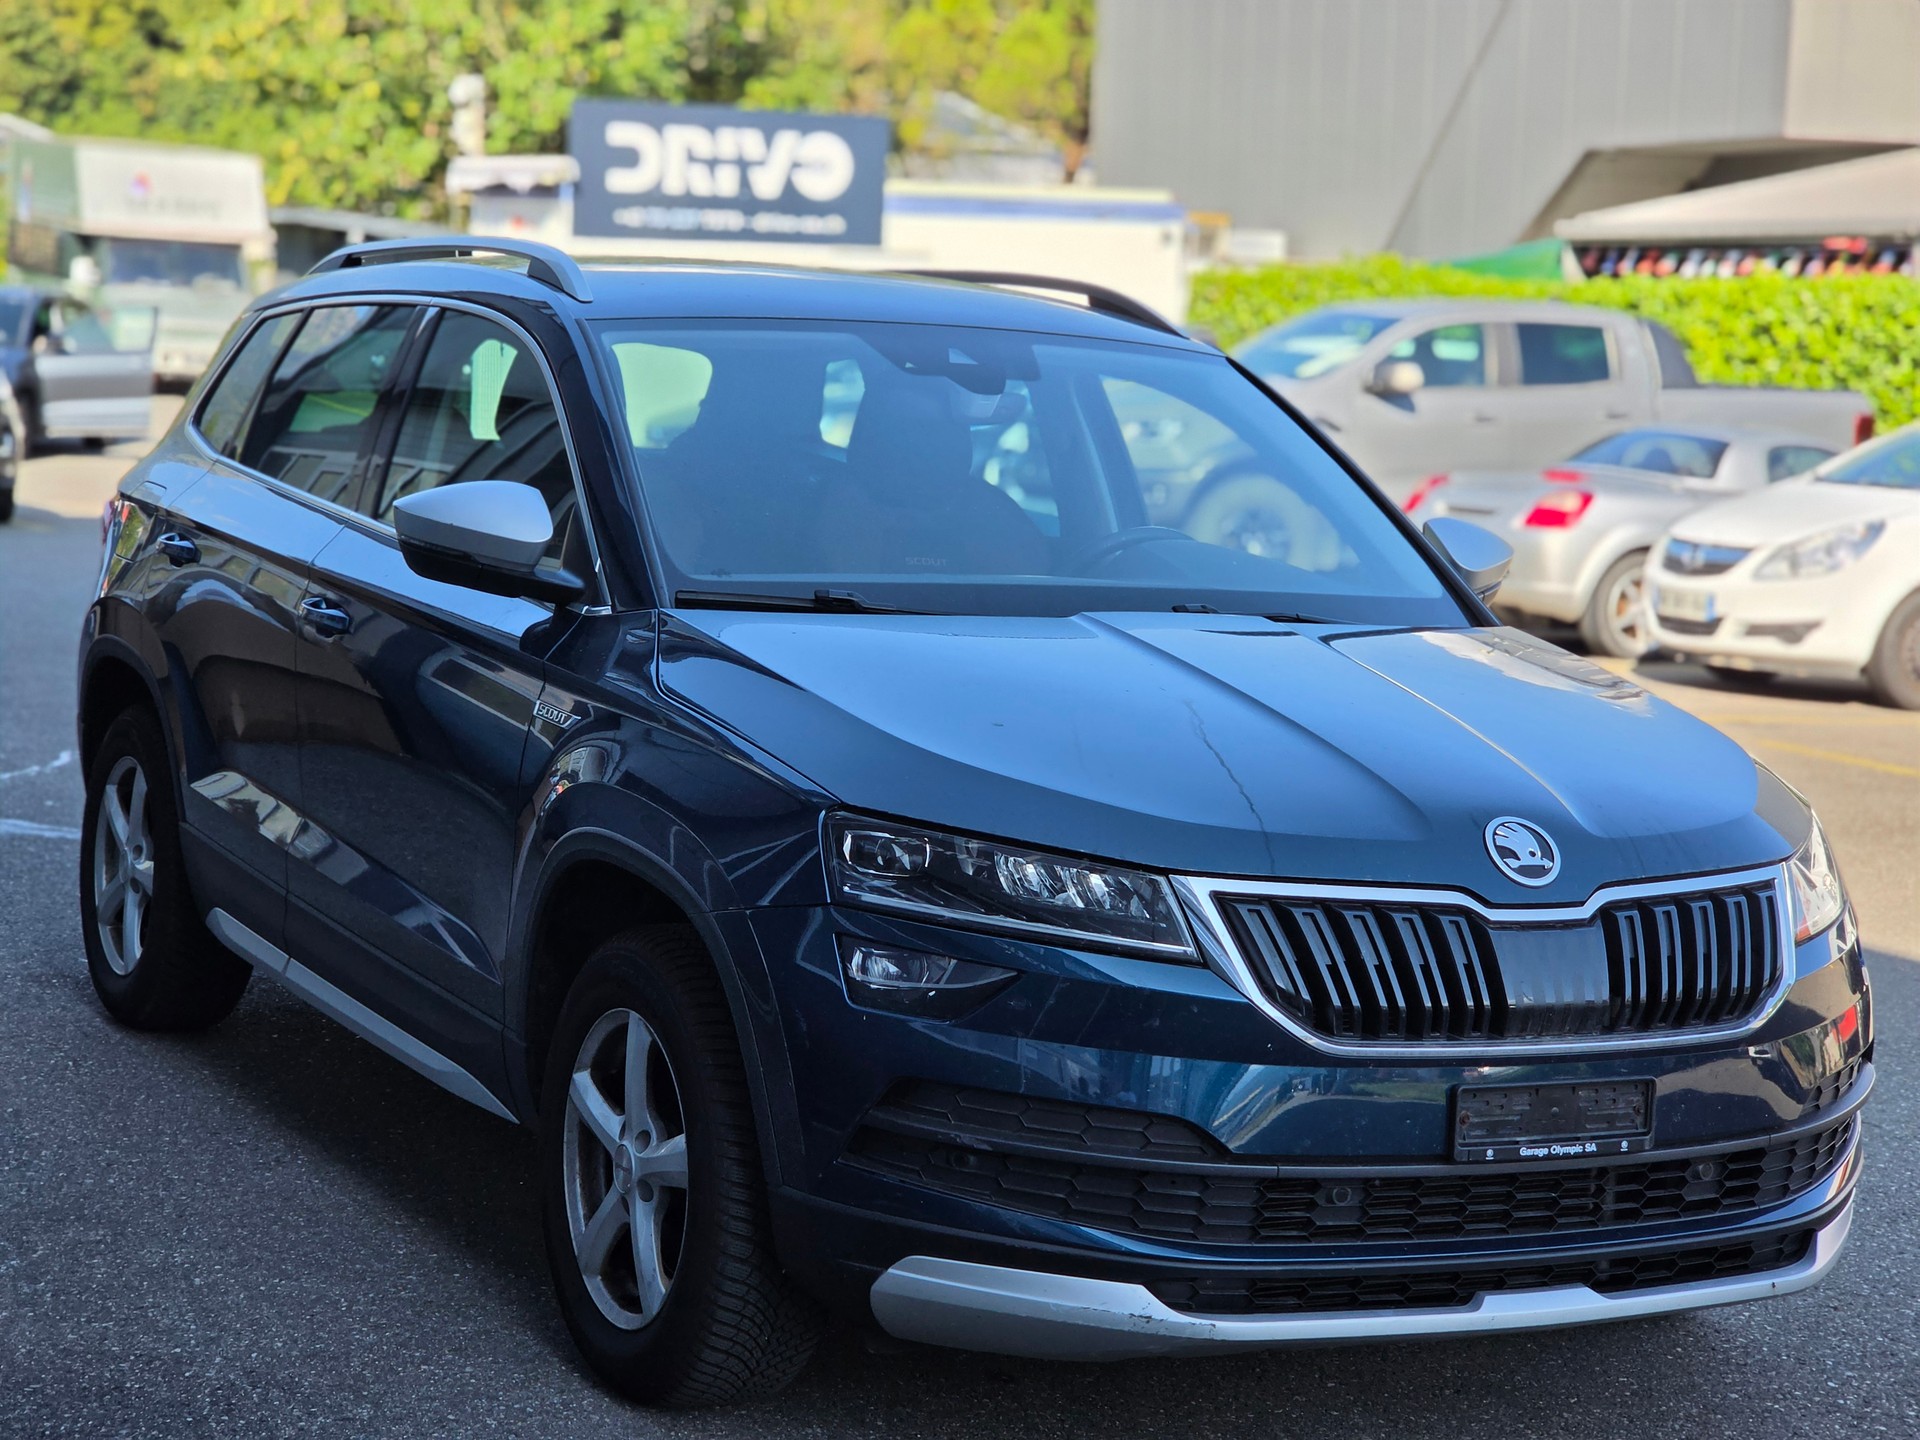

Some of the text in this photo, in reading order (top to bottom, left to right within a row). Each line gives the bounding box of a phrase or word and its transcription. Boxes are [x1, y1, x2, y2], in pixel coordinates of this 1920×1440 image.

[905, 557, 947, 567] SCOUT
[537, 703, 568, 724] SCOUT
[1520, 1142, 1597, 1157] Garage Olympic SA
